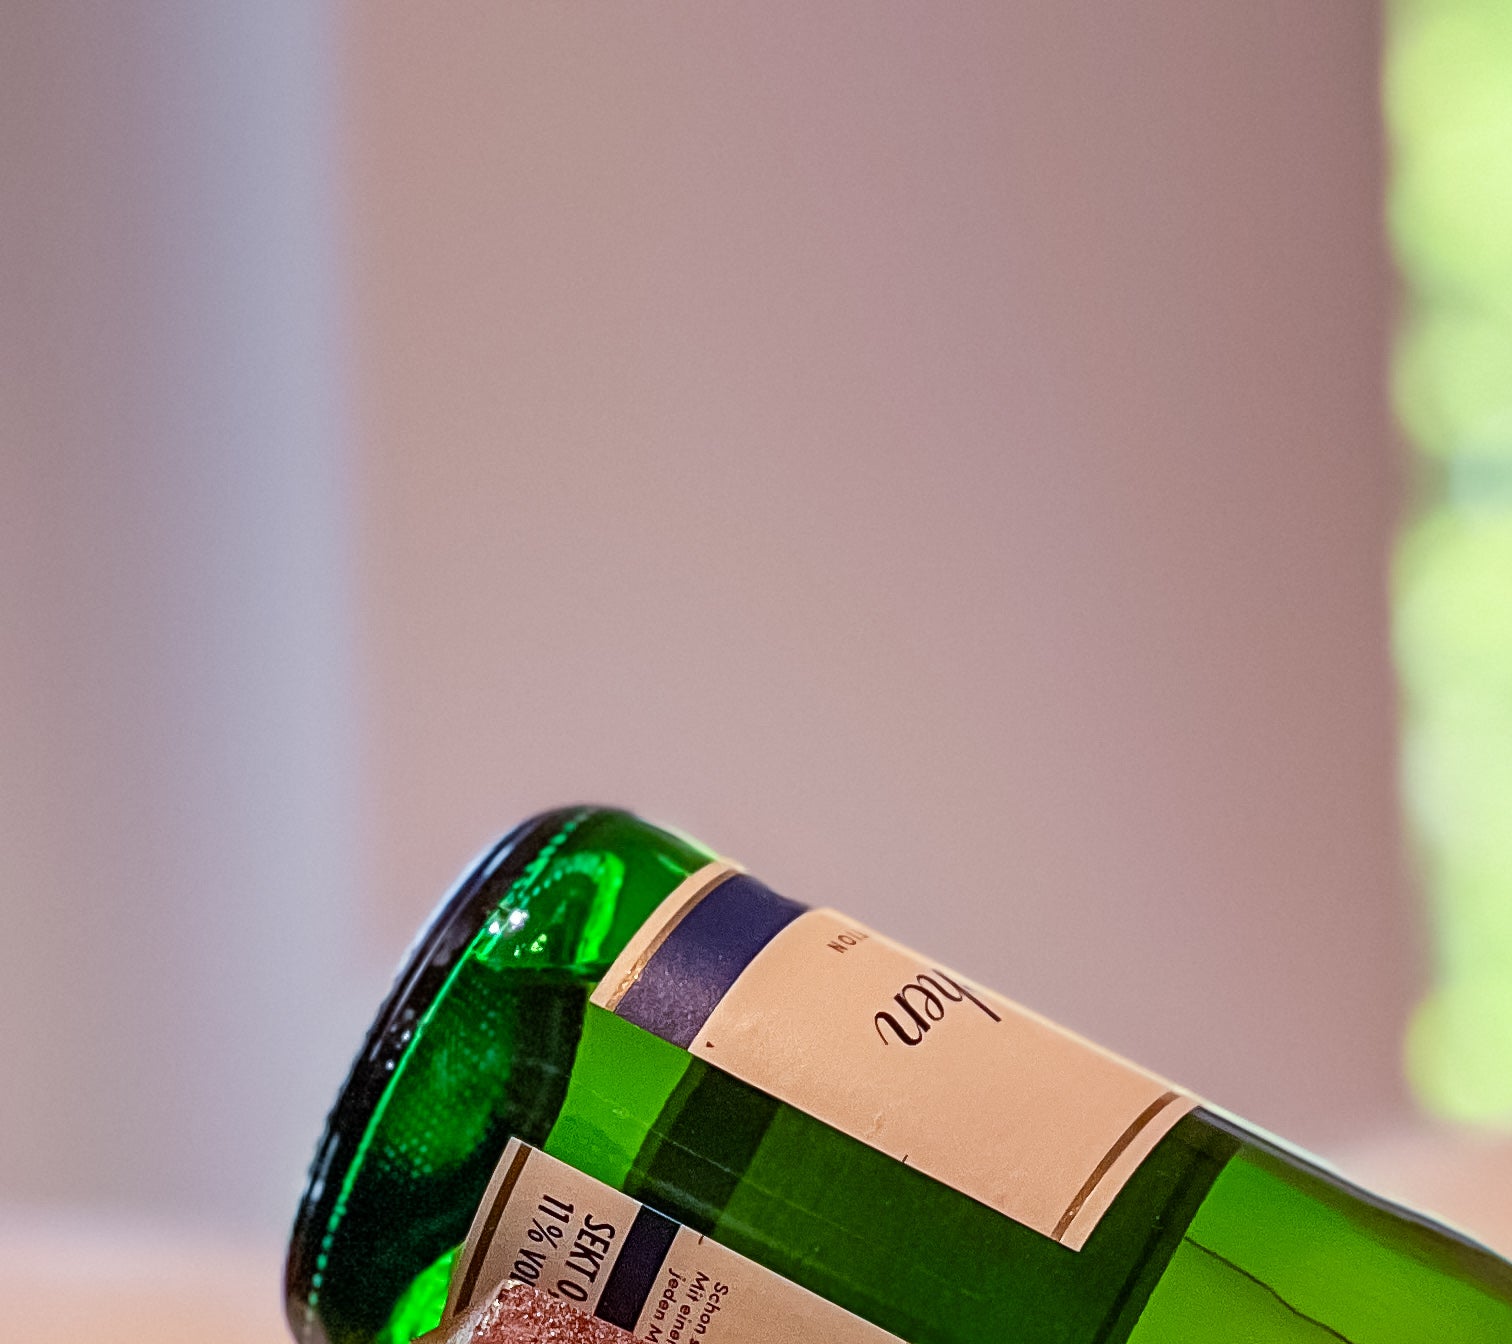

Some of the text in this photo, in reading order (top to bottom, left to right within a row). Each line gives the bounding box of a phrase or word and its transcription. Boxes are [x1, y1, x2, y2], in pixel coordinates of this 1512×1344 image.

[565, 1213, 616, 1284] SEKT
[653, 1267, 687, 1321] jeden
[686, 1271, 711, 1302] Mit
[694, 1281, 730, 1335] Schon
